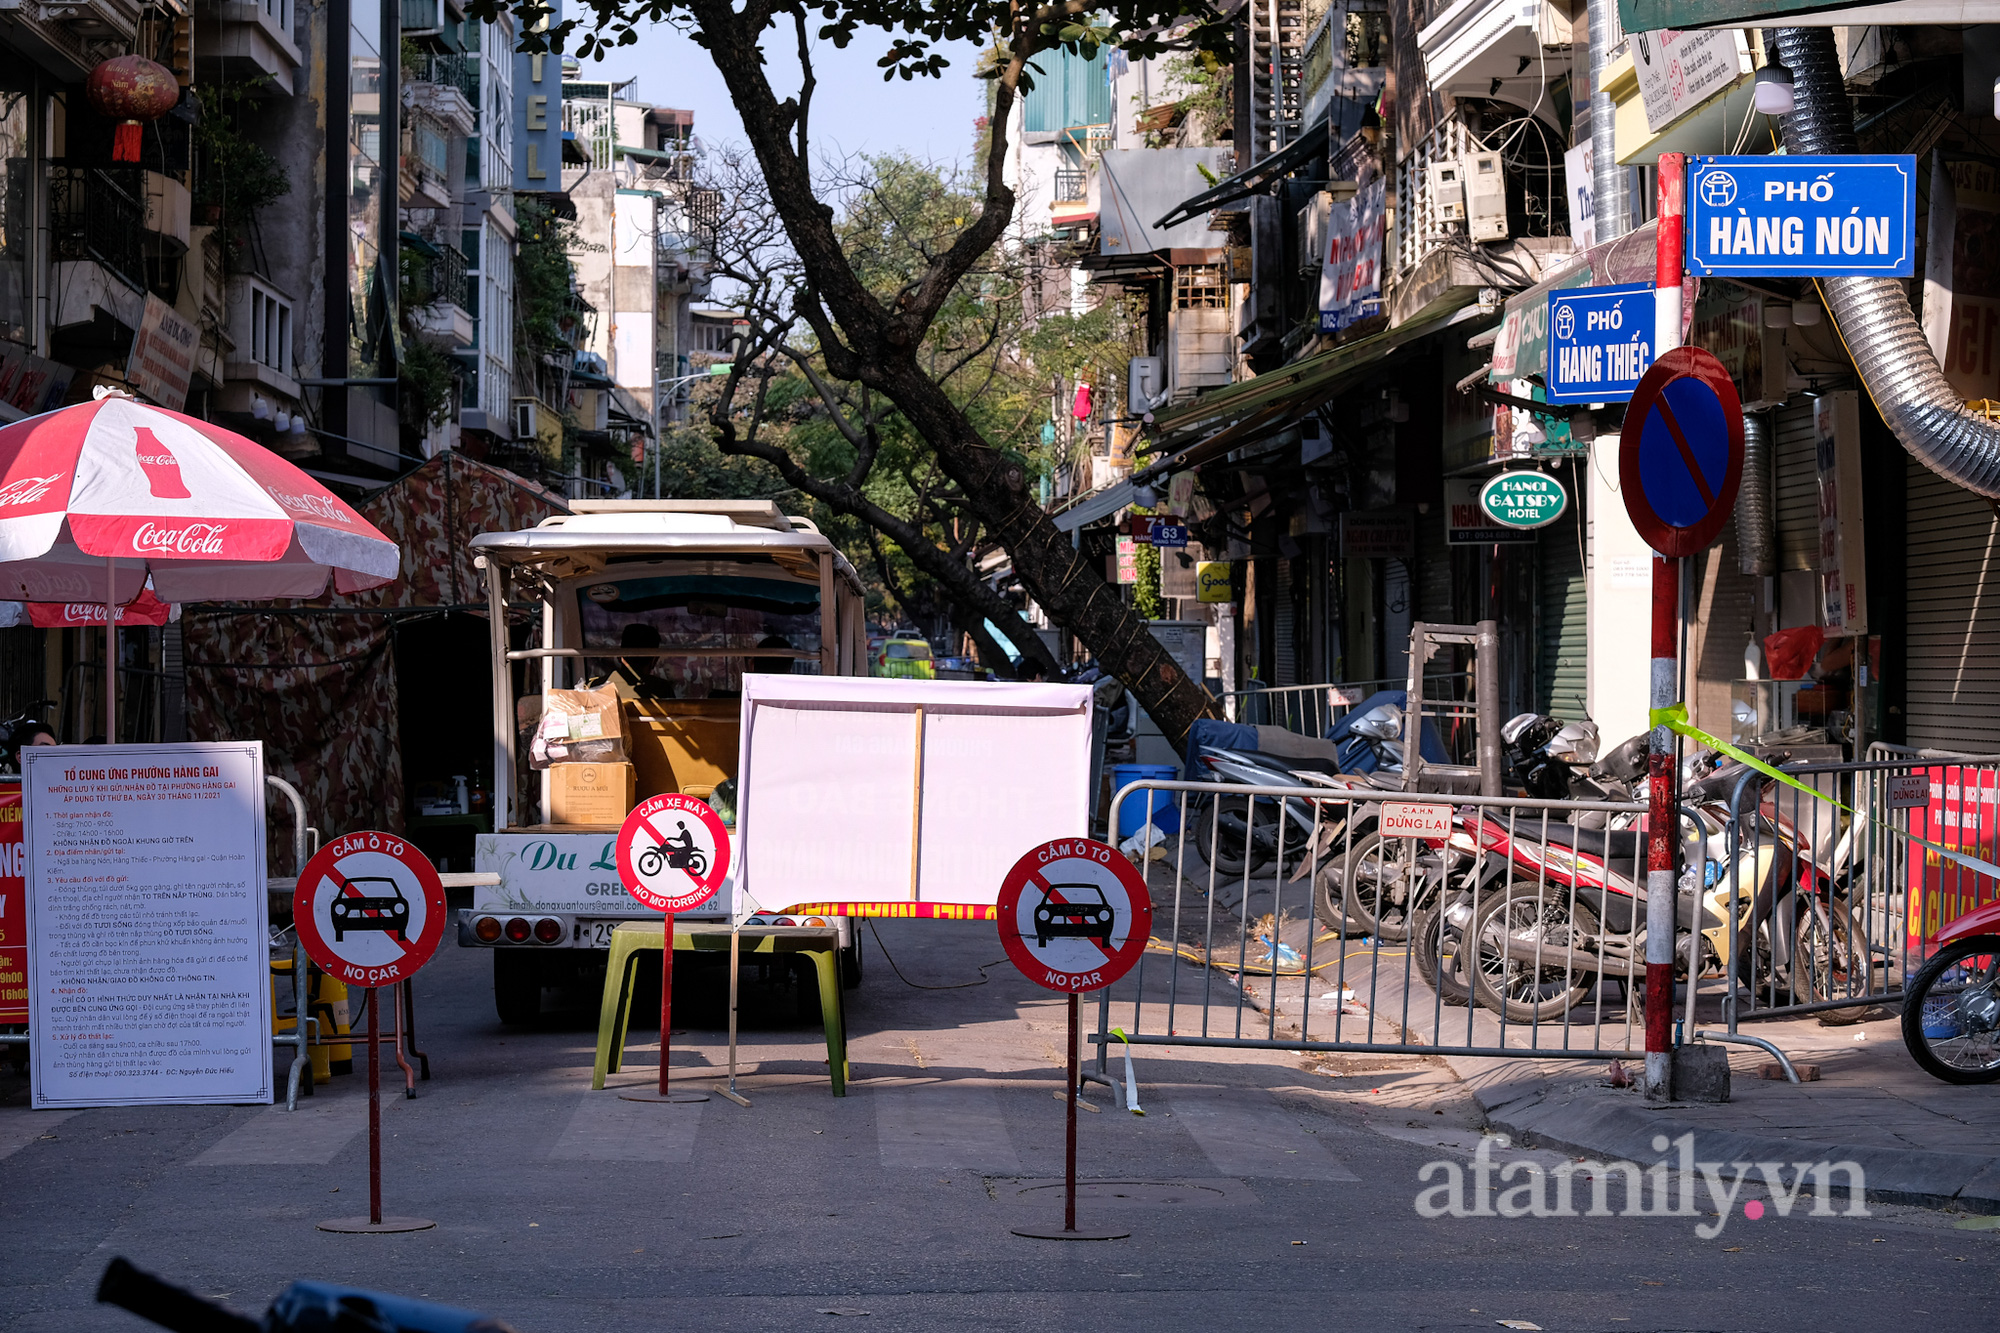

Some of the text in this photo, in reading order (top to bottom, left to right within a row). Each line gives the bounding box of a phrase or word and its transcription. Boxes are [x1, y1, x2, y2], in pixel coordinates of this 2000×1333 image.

[1764, 172, 1834, 201] PHỐ
[1710, 206, 1890, 255] HÀNG NÓN
[1587, 299, 1624, 331] PHỐ
[1559, 338, 1602, 383] HÀNG
[1606, 330, 1650, 381] THIẾC
[1502, 482, 1547, 492] HANOI
[1488, 494, 1560, 508] GATSBY
[1508, 509, 1540, 519] HOTEL
[133, 522, 228, 554] Coca-Cola
[1162, 528, 1177, 539] 63
[64, 766, 218, 780] TỔ CUNG ỨNG PHƯỜNG HÀNG GAI
[110, 783, 145, 792] GỬI/NHẬN
[1893, 787, 1928, 800] DỪNG LẠI
[1929, 779, 1944, 799] PHÒN
[1946, 780, 1962, 801] CHỐN
[640, 798, 708, 817] CẤM XE MÁY
[1386, 814, 1446, 832] DỪNG LẠI
[1935, 807, 1956, 827] PHỜNG
[1972, 813, 1982, 829] GI
[79, 838, 100, 846] NHẬN
[333, 835, 404, 857] CẤM Ô TÔ
[520, 840, 580, 871] Du
[1038, 841, 1111, 863] CẤM Ô TÔ
[633, 884, 711, 908] NO MOTORBIKE
[87, 976, 126, 985] NHẬN/GIAO
[344, 965, 400, 980] NO CAR
[1045, 971, 1103, 988] NO CAR
[1, 988, 28, 1000] 16h00
[185, 992, 206, 1001] NHẬN
